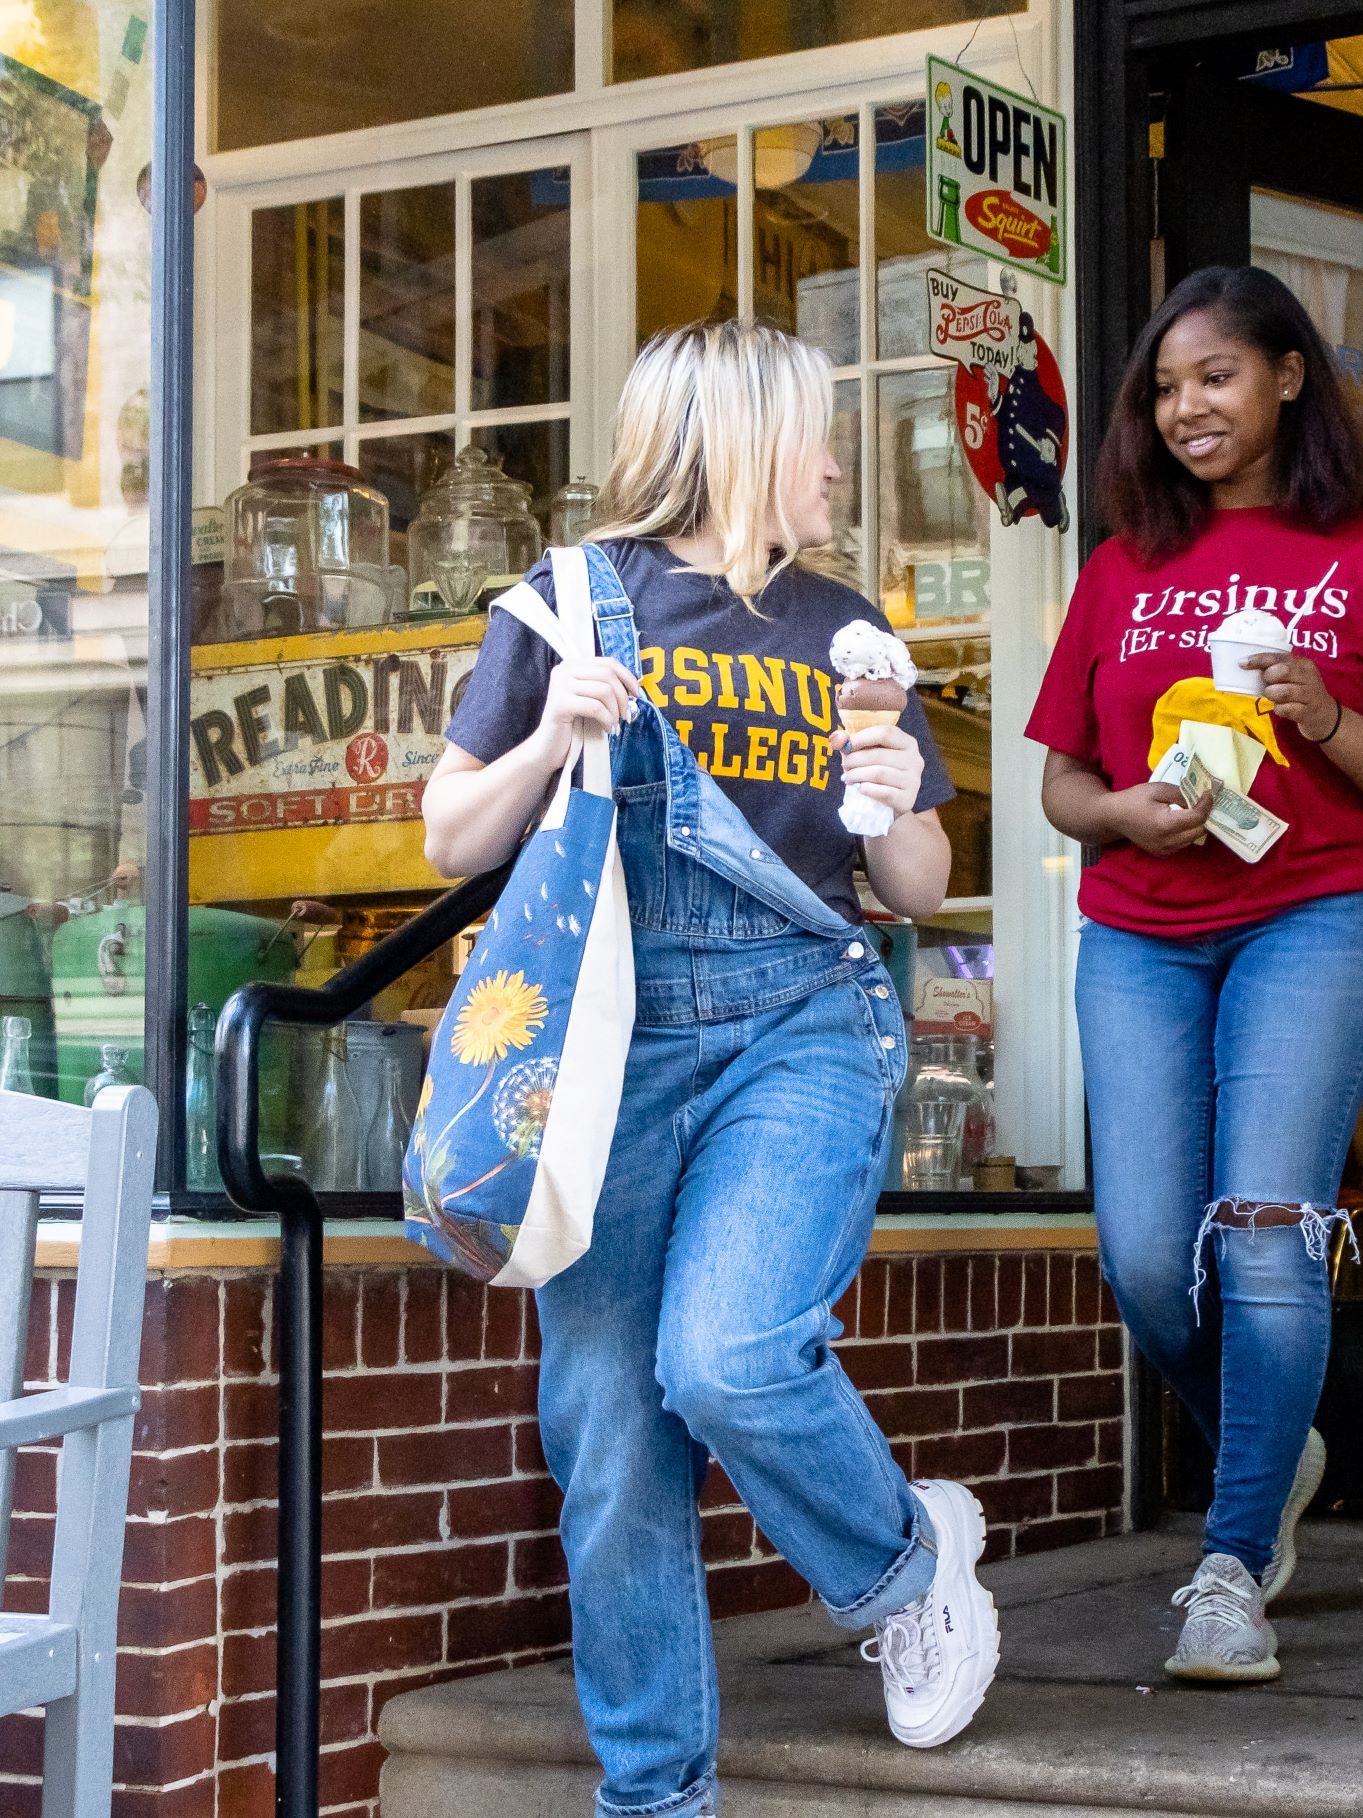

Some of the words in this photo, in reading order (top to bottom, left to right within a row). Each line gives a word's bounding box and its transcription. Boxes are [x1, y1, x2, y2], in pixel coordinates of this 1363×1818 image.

[962, 84, 1057, 209] OPEN
[977, 196, 1042, 241] Squirt
[930, 277, 959, 302] BUY
[970, 340, 1014, 370] TODAY!
[964, 401, 989, 450] 5¢
[1131, 573, 1349, 622] Ursinus
[639, 646, 844, 733] RSINU
[402, 750, 438, 768] Since
[675, 719, 834, 791] LLEGE
[207, 794, 328, 824] SOFT
[349, 788, 416, 814] DR
[943, 1604, 955, 1634] FILA
